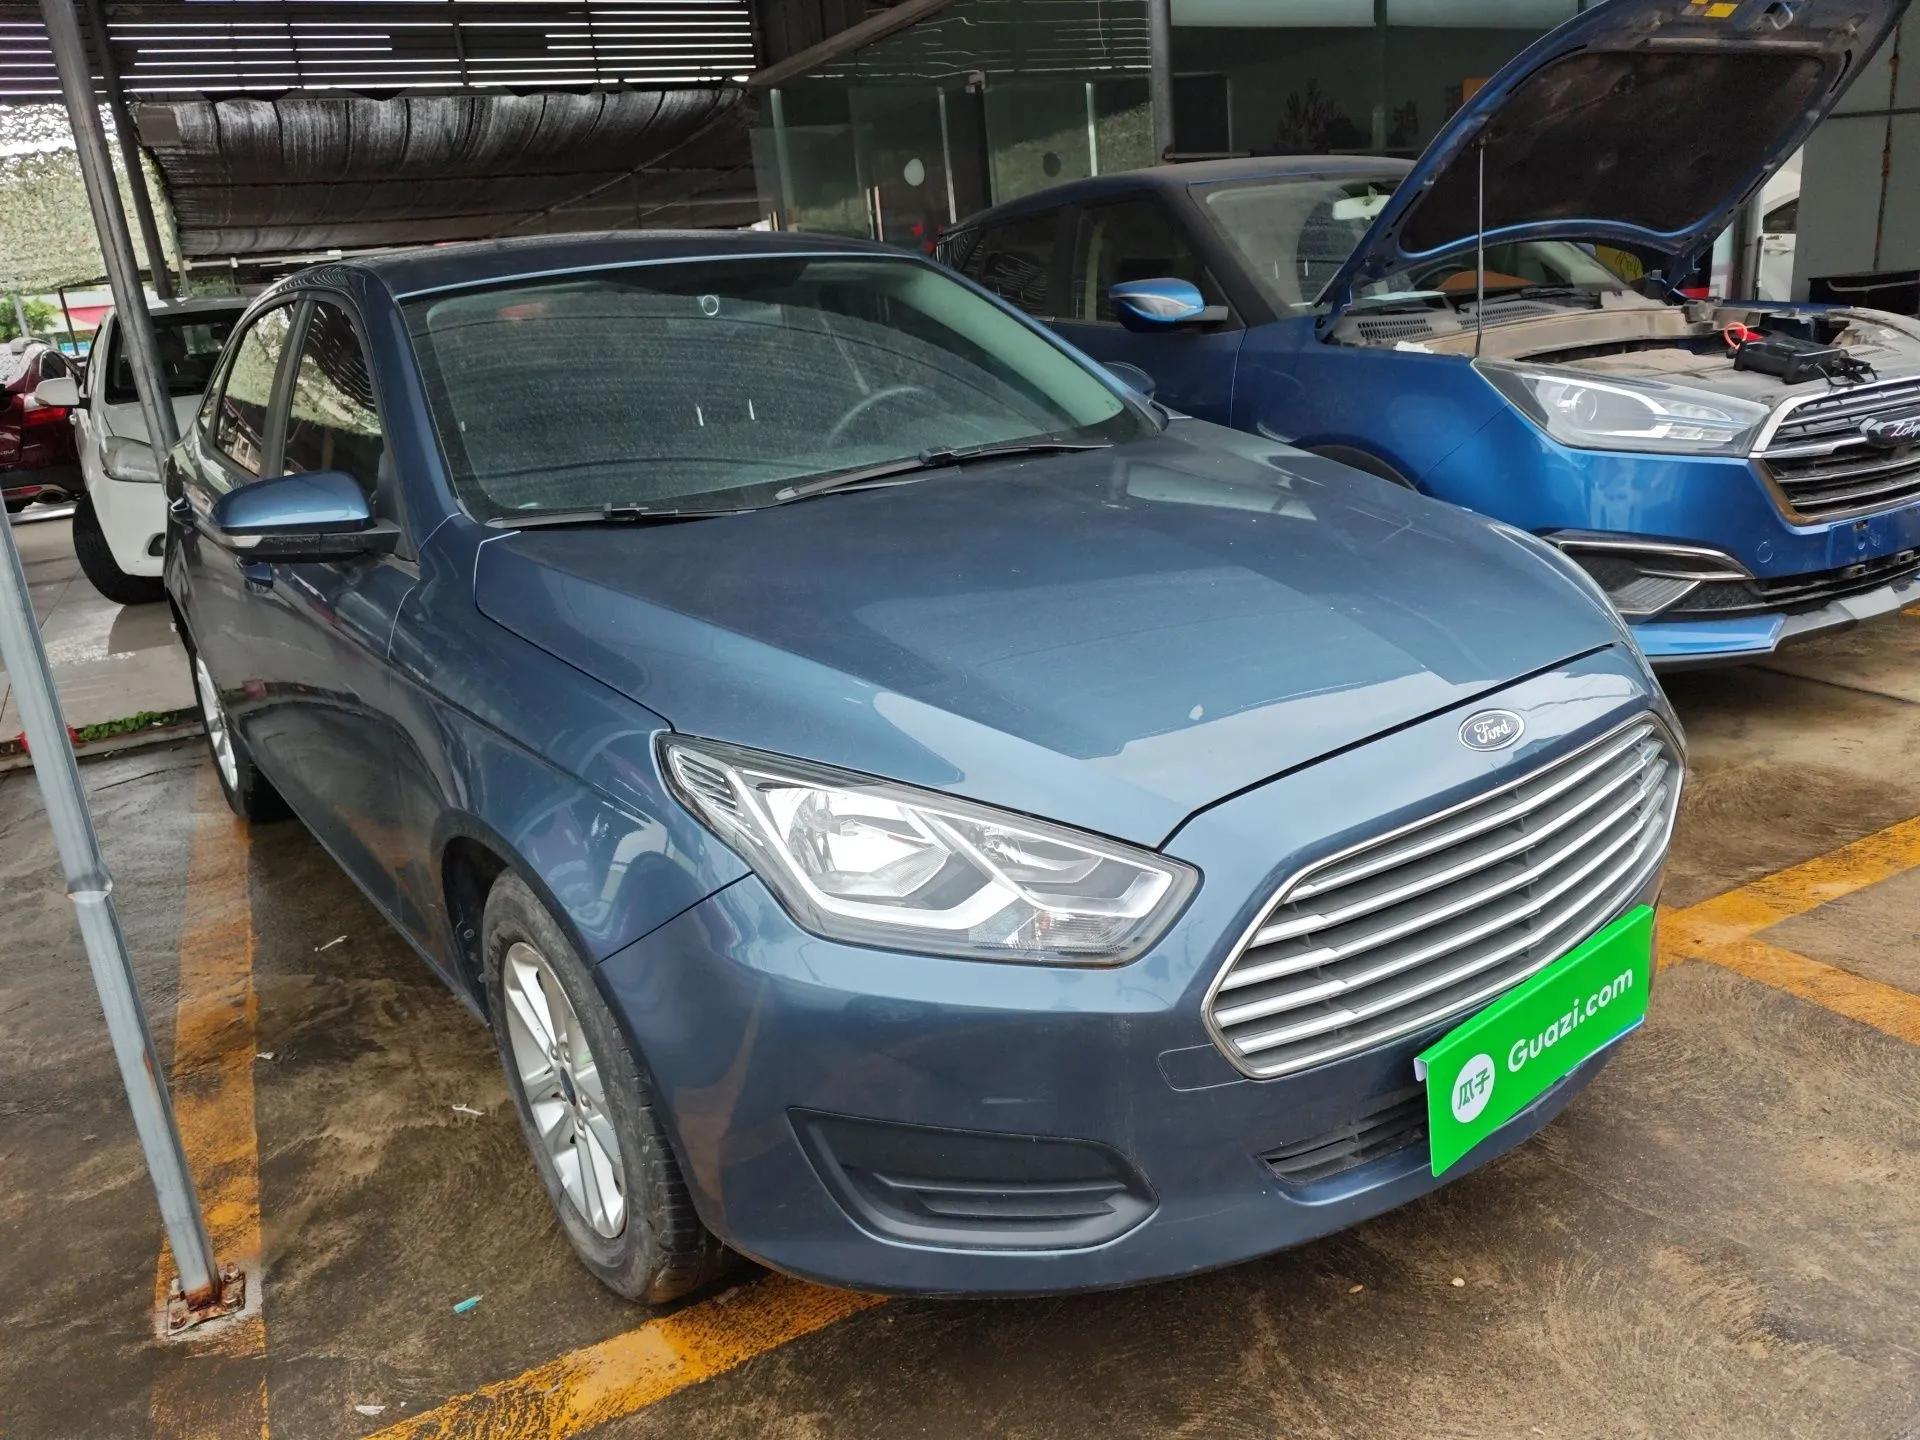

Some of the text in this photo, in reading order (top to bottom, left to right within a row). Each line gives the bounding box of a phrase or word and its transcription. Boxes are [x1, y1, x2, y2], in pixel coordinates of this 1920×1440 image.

[1473, 718, 1511, 744] Ford
[1507, 968, 1633, 1073] Guazi.com
[1457, 1067, 1491, 1110] 瓜子
